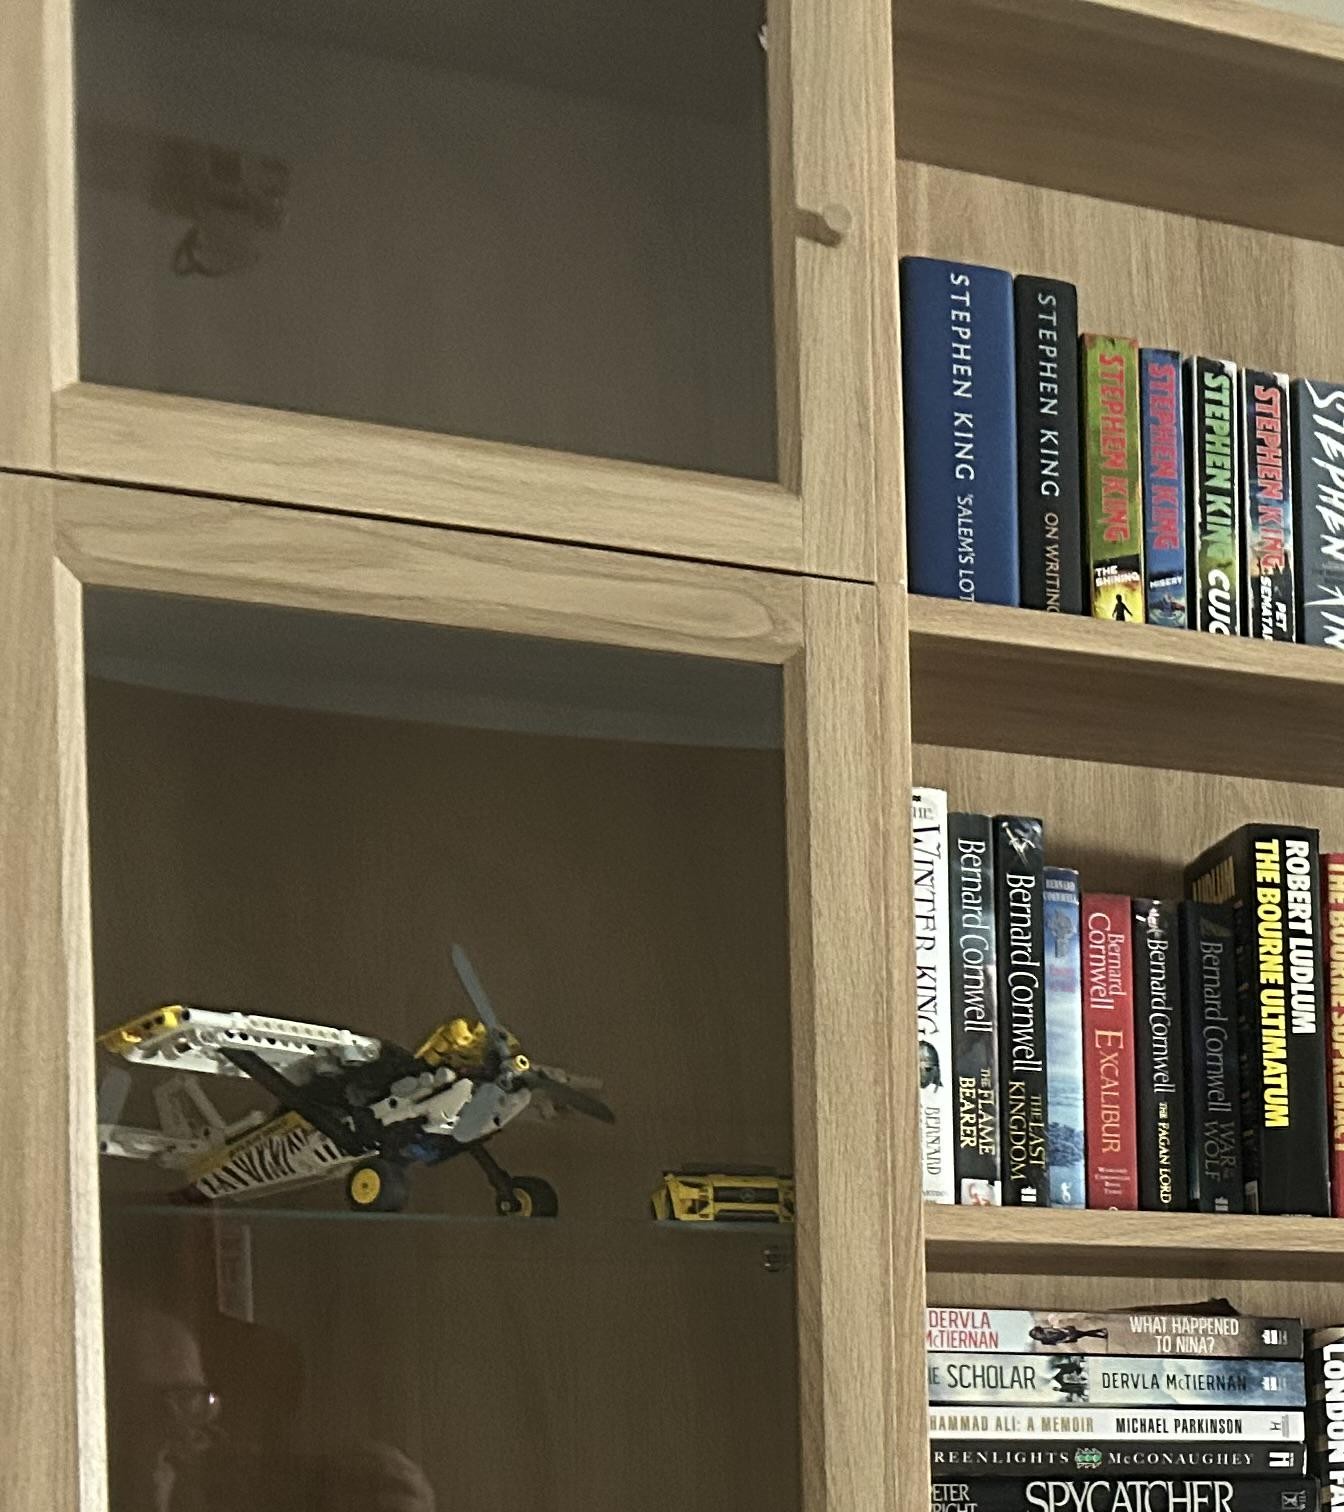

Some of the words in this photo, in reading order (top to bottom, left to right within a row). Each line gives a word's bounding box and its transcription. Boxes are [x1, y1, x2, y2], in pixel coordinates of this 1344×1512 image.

[1100, 354, 1126, 477] STEPHEN
[1149, 363, 1177, 479] STEPHEN
[1255, 385, 1281, 500] STEPHEN
[1103, 486, 1130, 544] KING
[1150, 487, 1177, 549] KING
[1256, 507, 1284, 570] KING
[1095, 573, 1140, 586] SHINING
[1150, 575, 1182, 589] MISERY
[957, 839, 986, 929] Bernard
[1255, 839, 1279, 884] THE
[1285, 840, 1311, 926] ROBERT
[1007, 873, 1038, 966] Bernard
[1088, 912, 1114, 1010] Cornwell
[1256, 889, 1282, 985] BOURNE
[960, 935, 992, 1032] Cornwell
[1012, 972, 1043, 1072] Cornwell
[1291, 932, 1316, 1033] LUDLUM
[1094, 1029, 1123, 1152] EXCALIBUR
[1260, 989, 1289, 1127] ULTIMATUM
[959, 1076, 977, 1148] BEARER
[1007, 1081, 1026, 1181] KINGDOM
[1129, 1317, 1168, 1334] WHAT
[1172, 1318, 1239, 1335] HAPPENED
